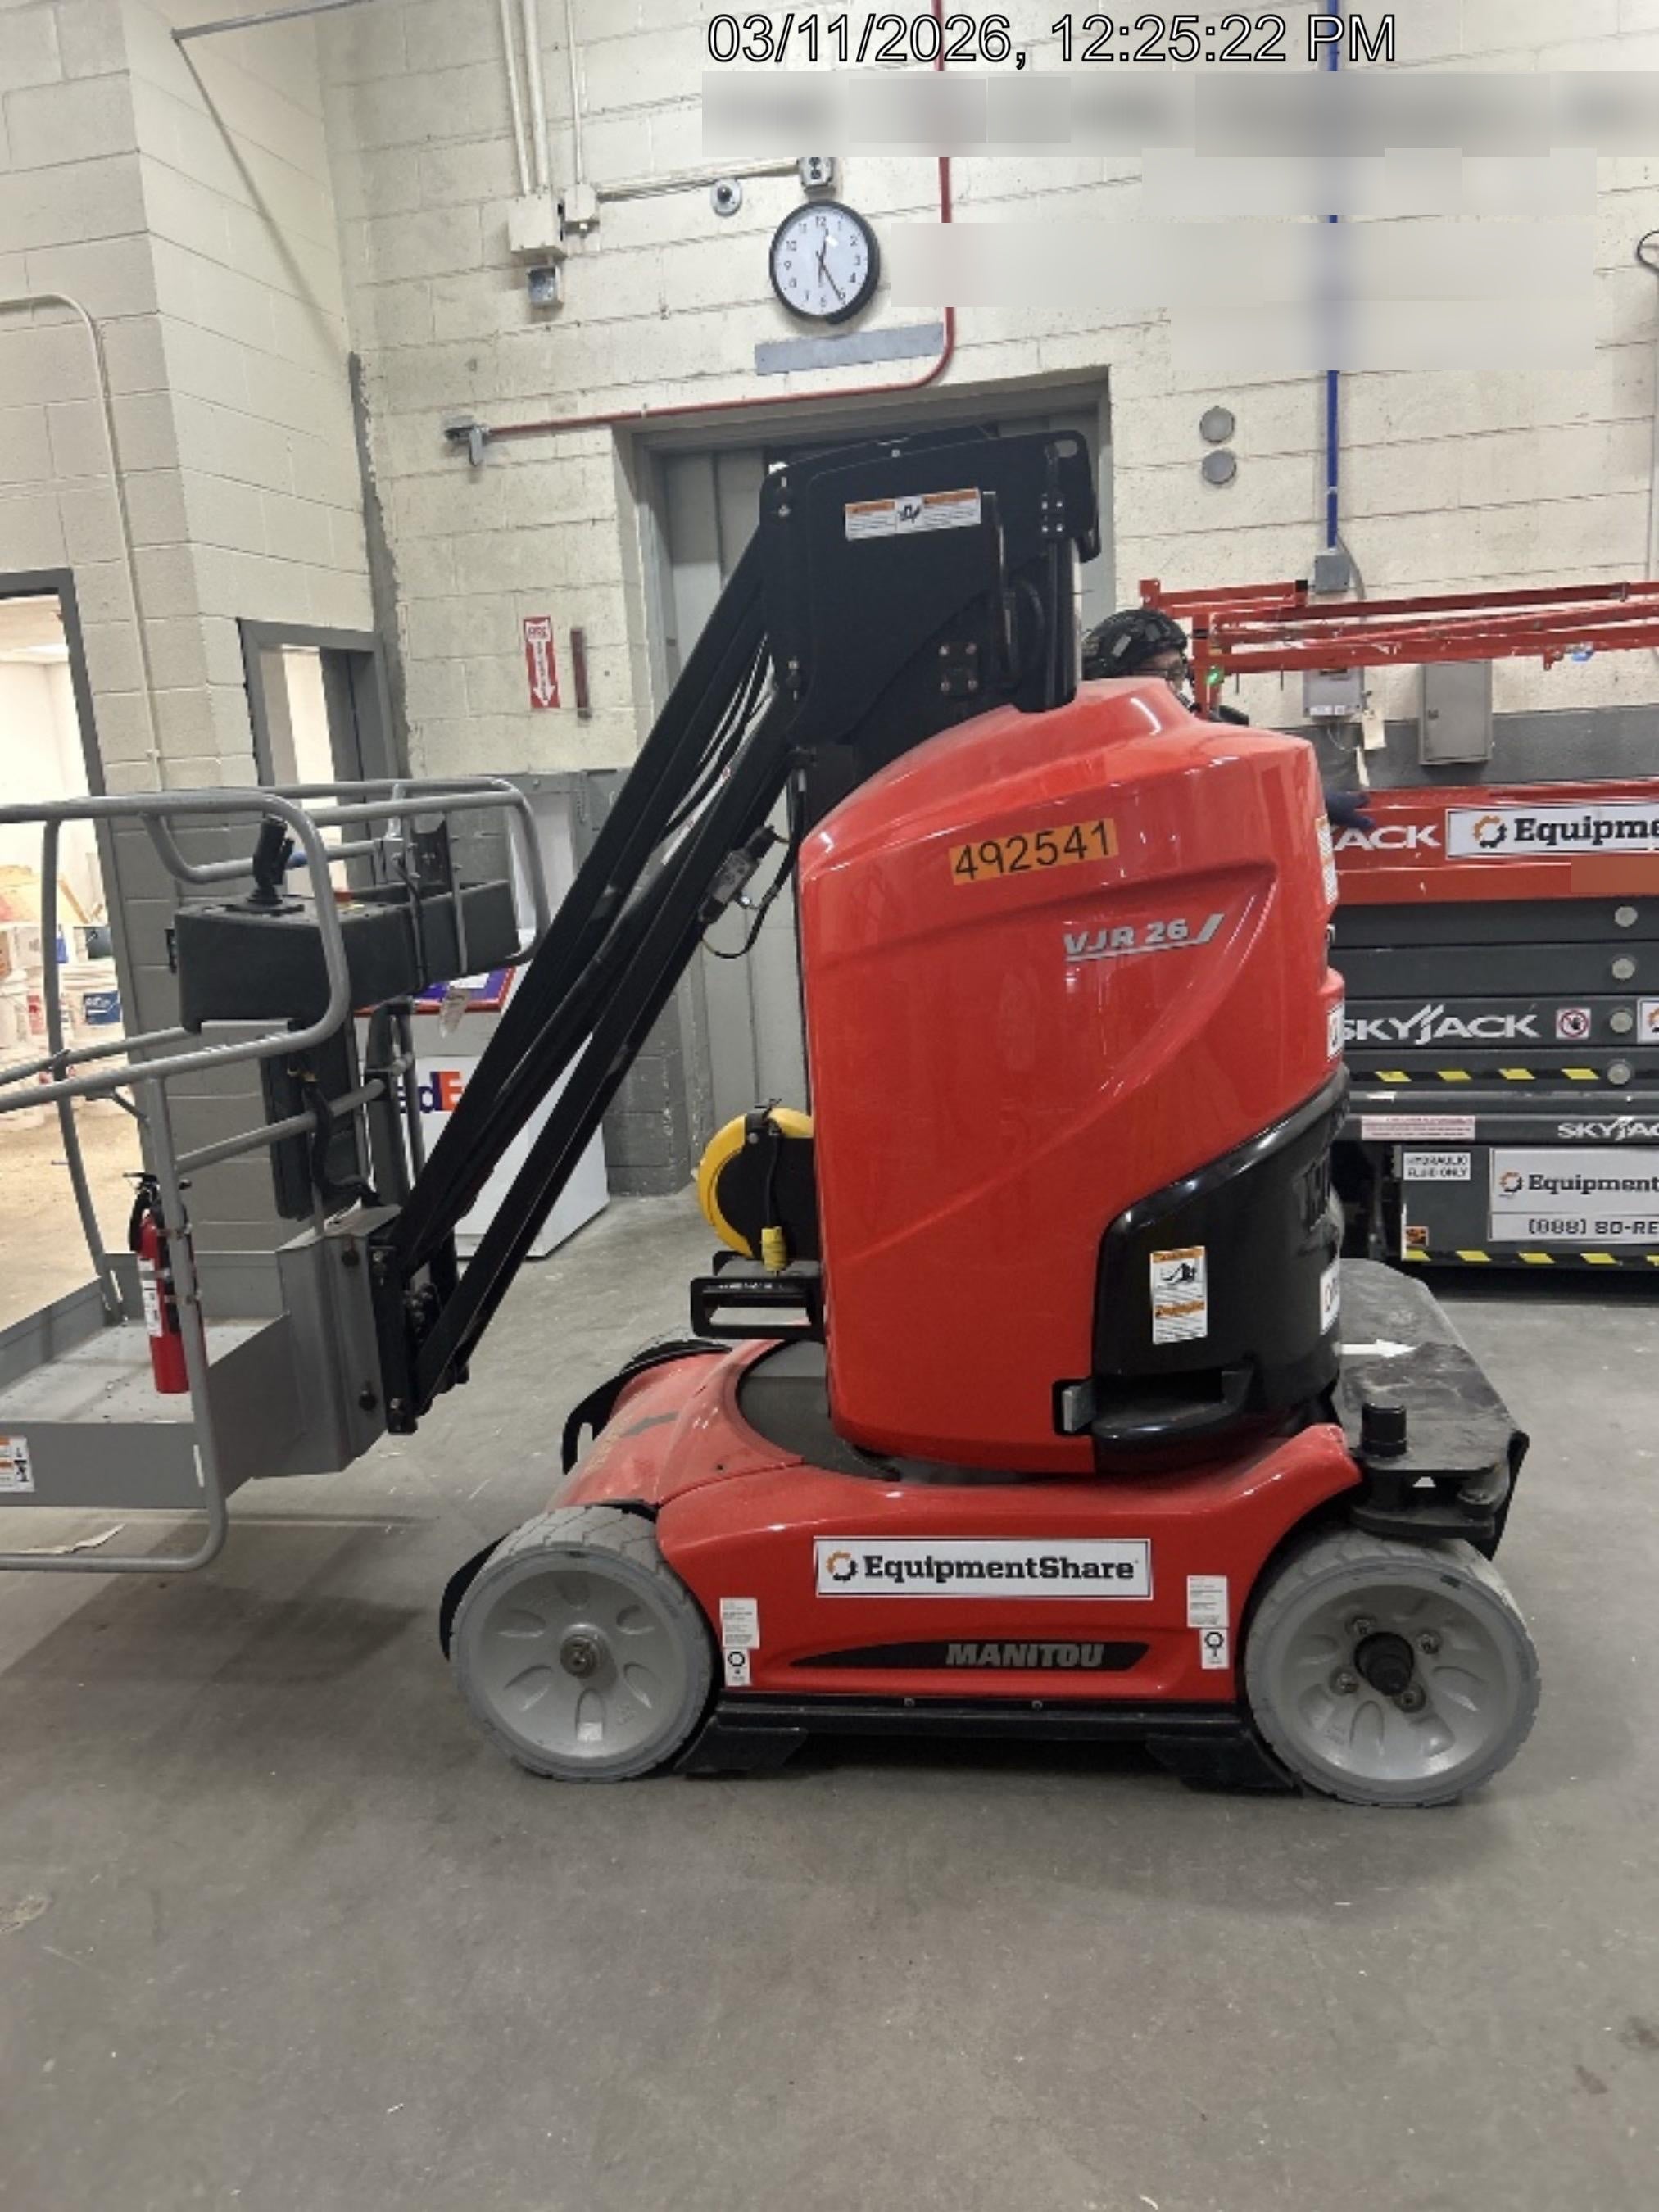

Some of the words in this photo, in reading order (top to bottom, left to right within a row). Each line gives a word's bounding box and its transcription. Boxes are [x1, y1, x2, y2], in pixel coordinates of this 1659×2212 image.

[815, 216, 826, 227] 12
[954, 821, 1109, 880] 492541
[1330, 825, 1441, 851] ACK
[1064, 927, 1135, 955] VJR
[1145, 918, 1188, 942] 26
[1528, 1174, 1659, 1195] Equipment
[864, 1555, 1134, 1583] EquipmentShare
[945, 1643, 1104, 1668] MANITOU
